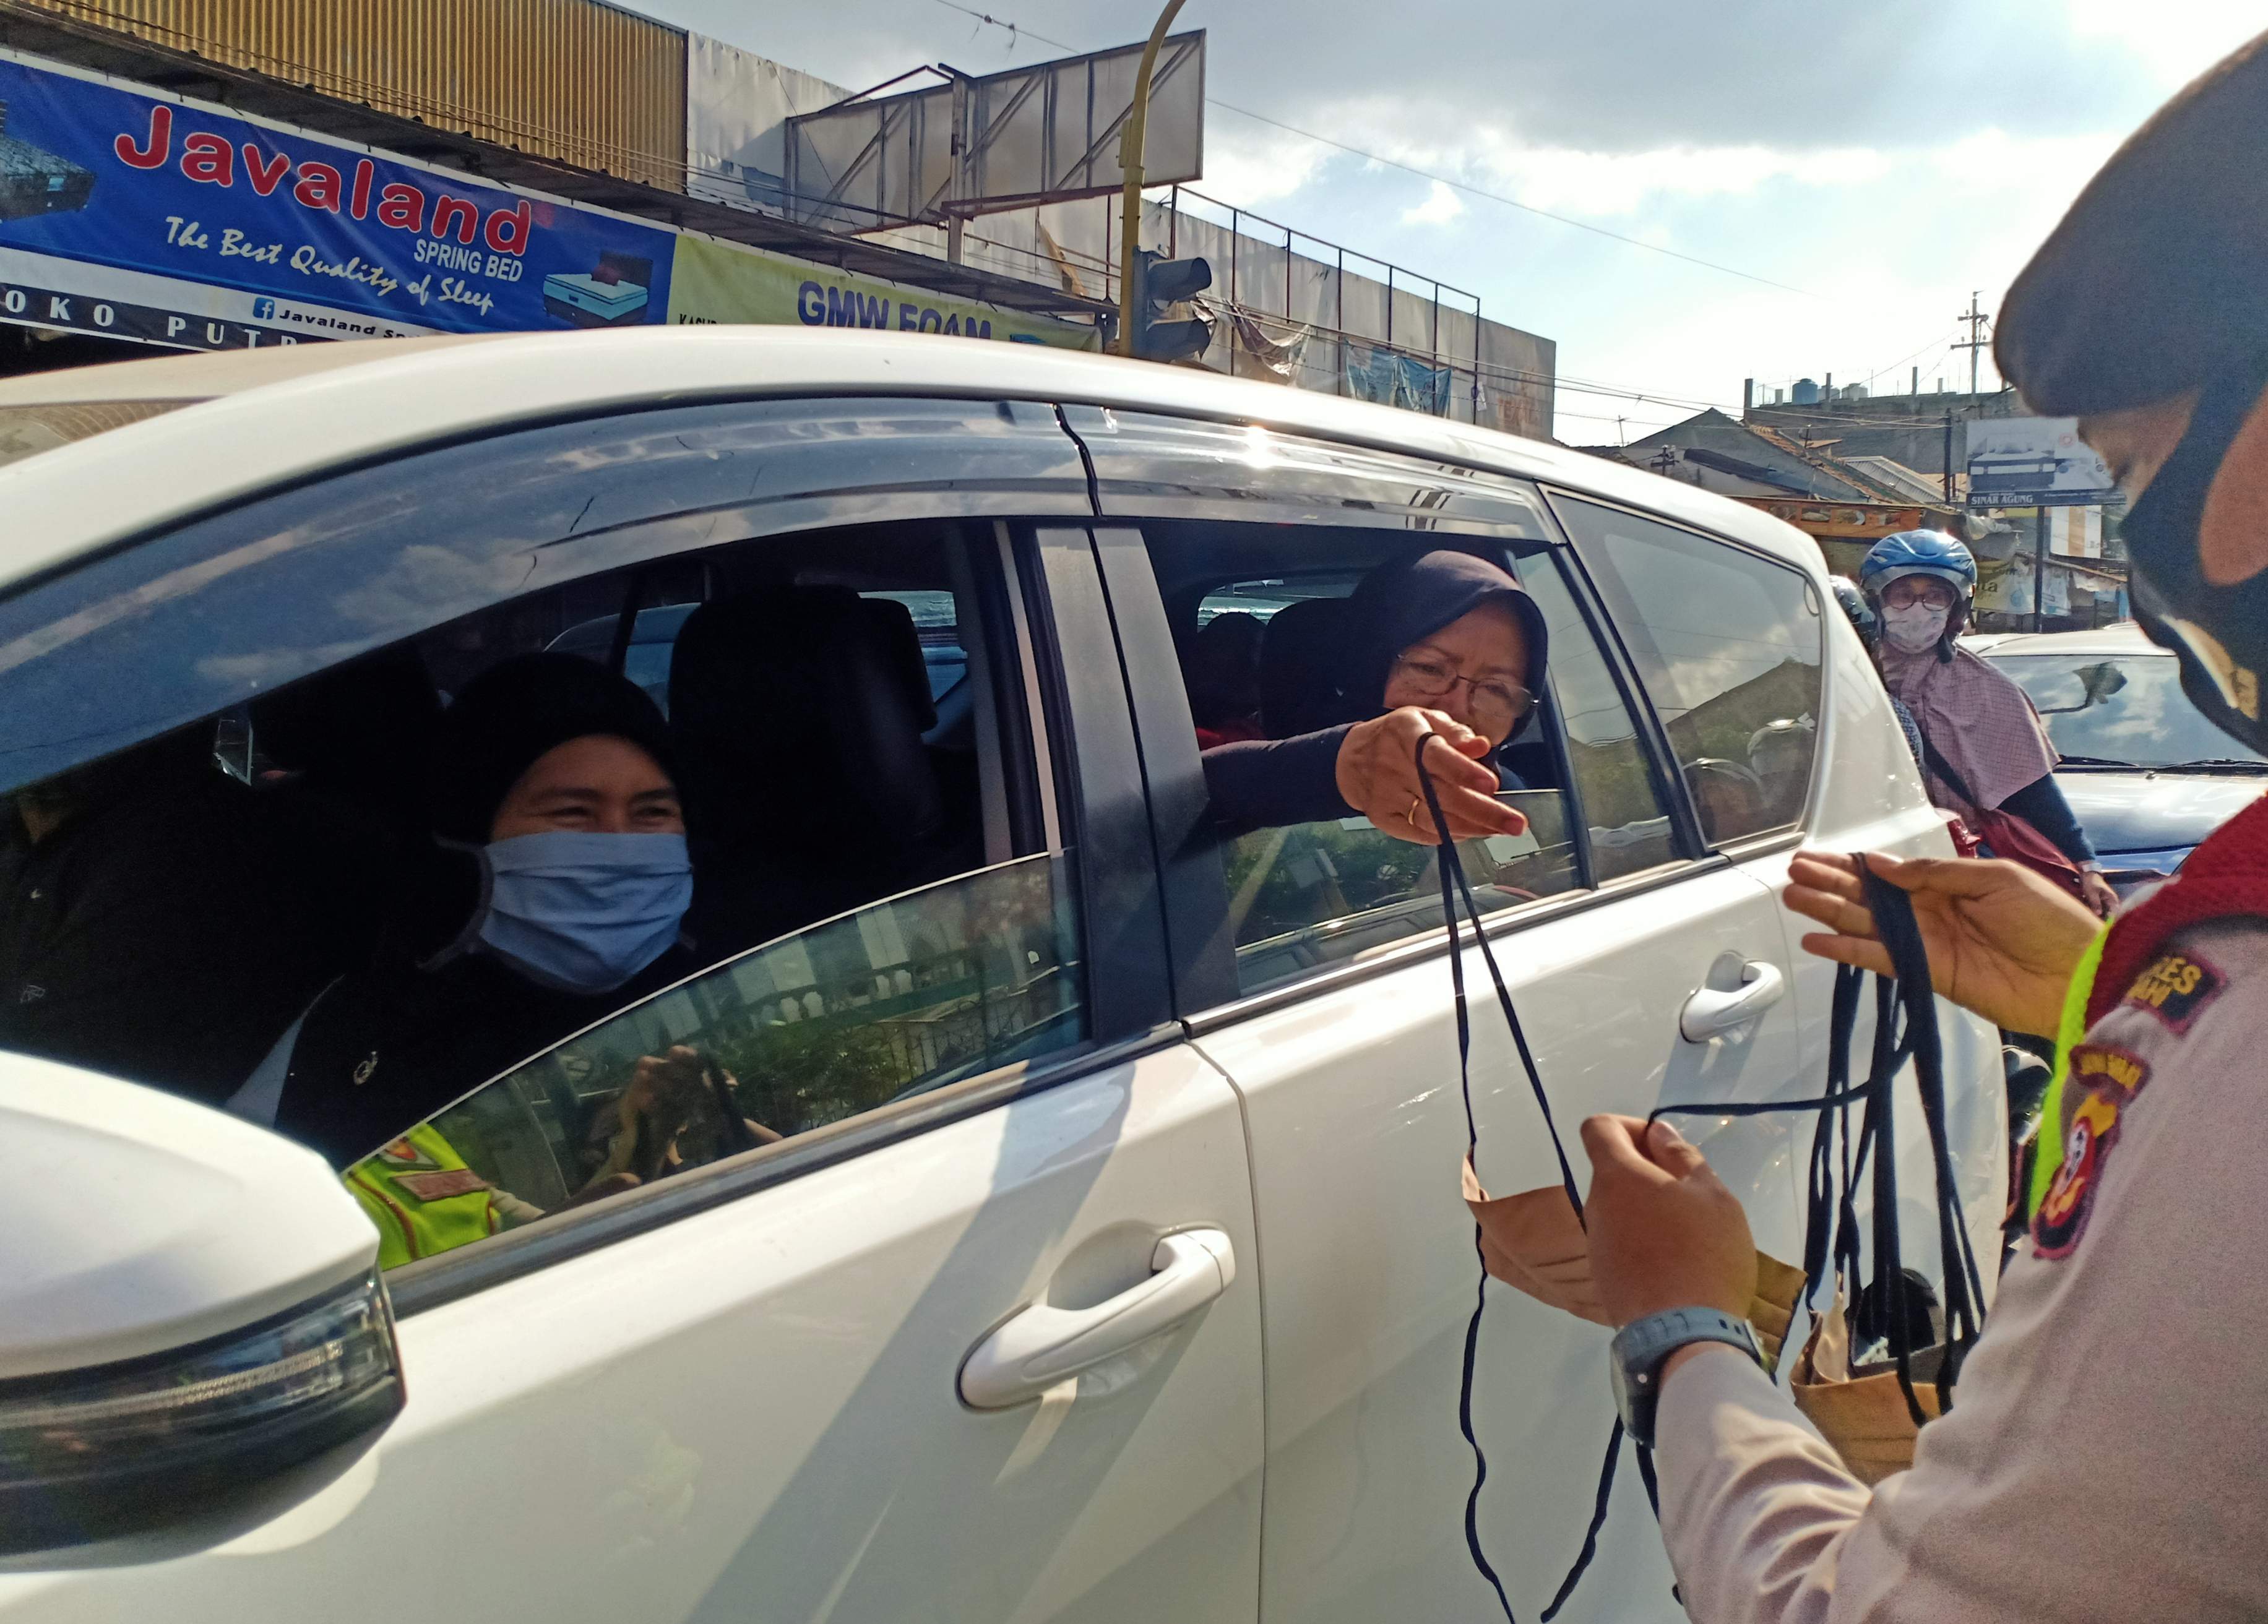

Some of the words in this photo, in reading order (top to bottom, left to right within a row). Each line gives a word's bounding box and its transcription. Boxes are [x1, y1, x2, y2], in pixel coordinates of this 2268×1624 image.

[114, 105, 532, 257] Javaland
[165, 216, 209, 249] The
[219, 228, 283, 264] Best
[290, 245, 398, 296] Quality
[406, 274, 431, 306] of
[438, 277, 494, 316] Sleep
[413, 238, 482, 274] SPRING
[485, 254, 523, 282] BED
[5, 290, 114, 327] OKO
[279, 309, 376, 335] Javaland
[798, 281, 890, 330] GMW
[1970, 496, 1999, 505] SINAR
[2001, 494, 2033, 504] AGUNG
